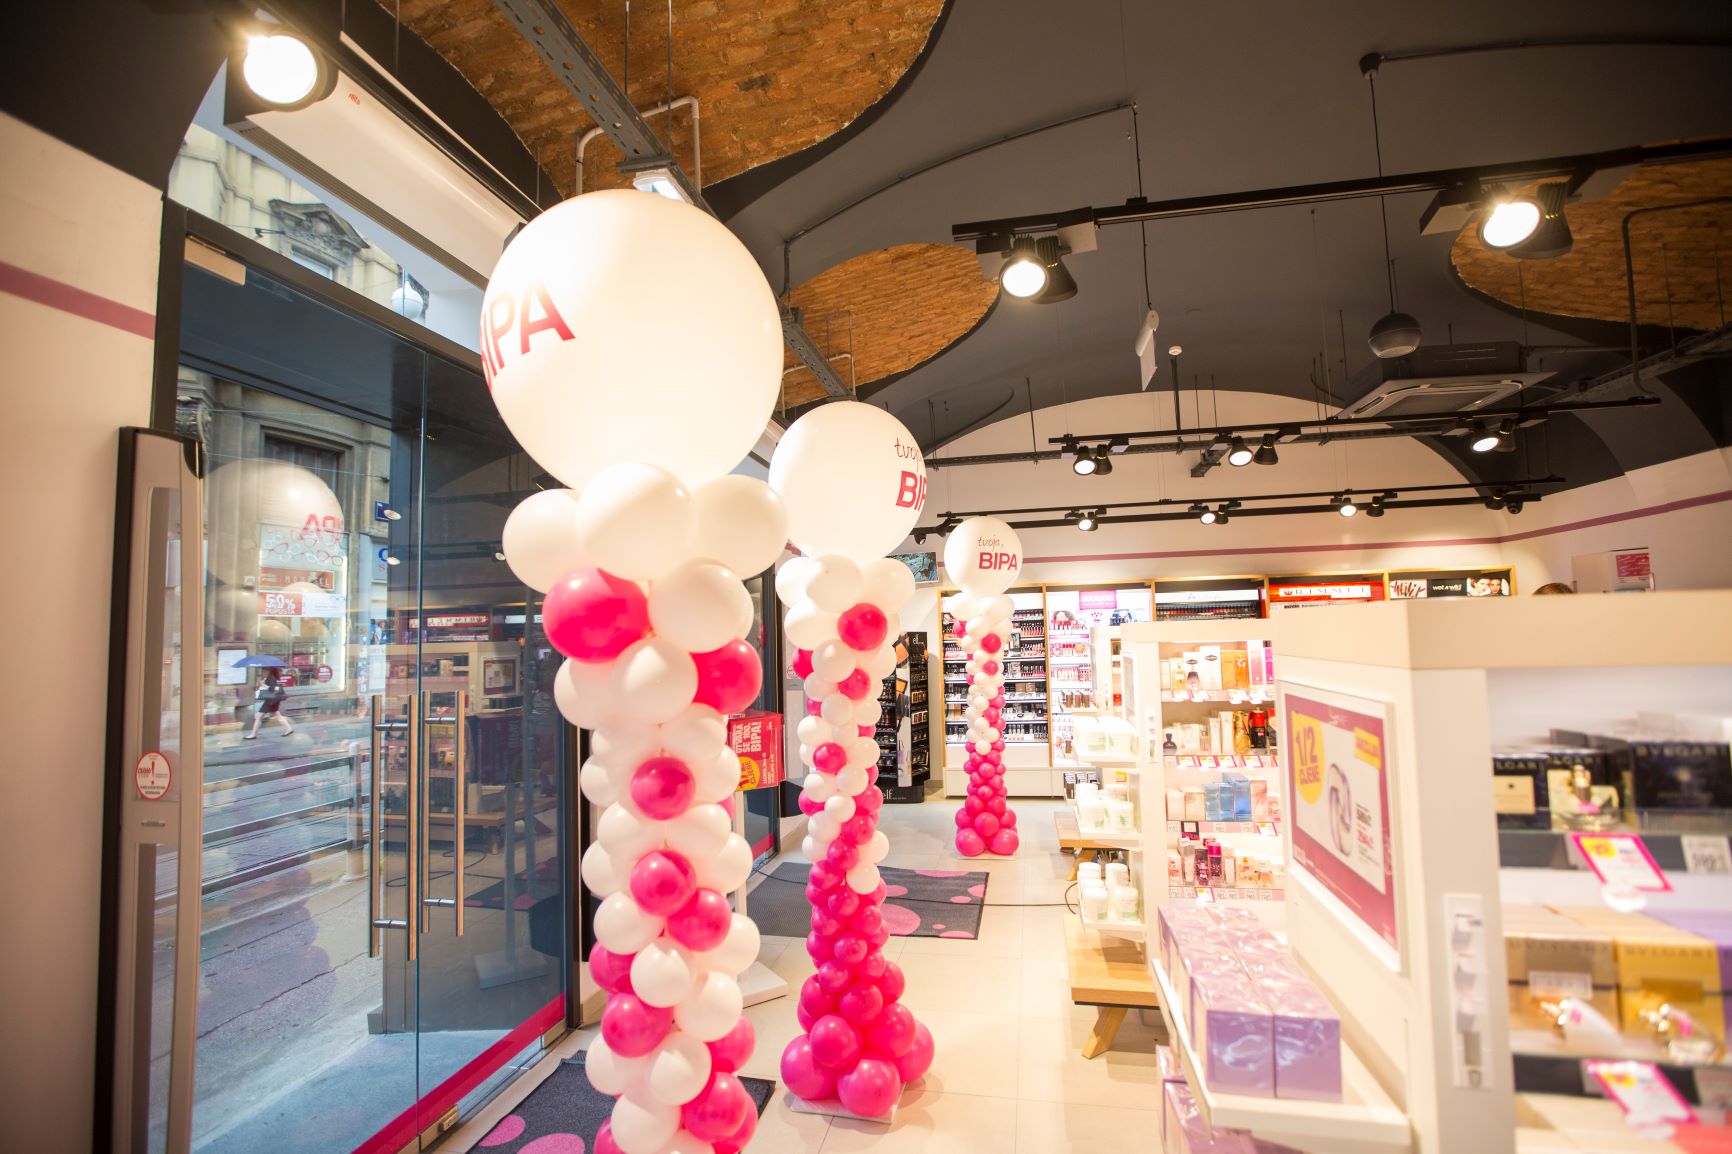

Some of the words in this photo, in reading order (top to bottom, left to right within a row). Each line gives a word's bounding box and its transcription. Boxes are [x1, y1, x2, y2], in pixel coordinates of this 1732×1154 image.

[979, 552, 1018, 570] BIPA
[735, 723, 744, 754] OTVARA
[743, 741, 751, 753] SE
[750, 721, 762, 752] BIPA!
[1295, 726, 1319, 768] 1/2
